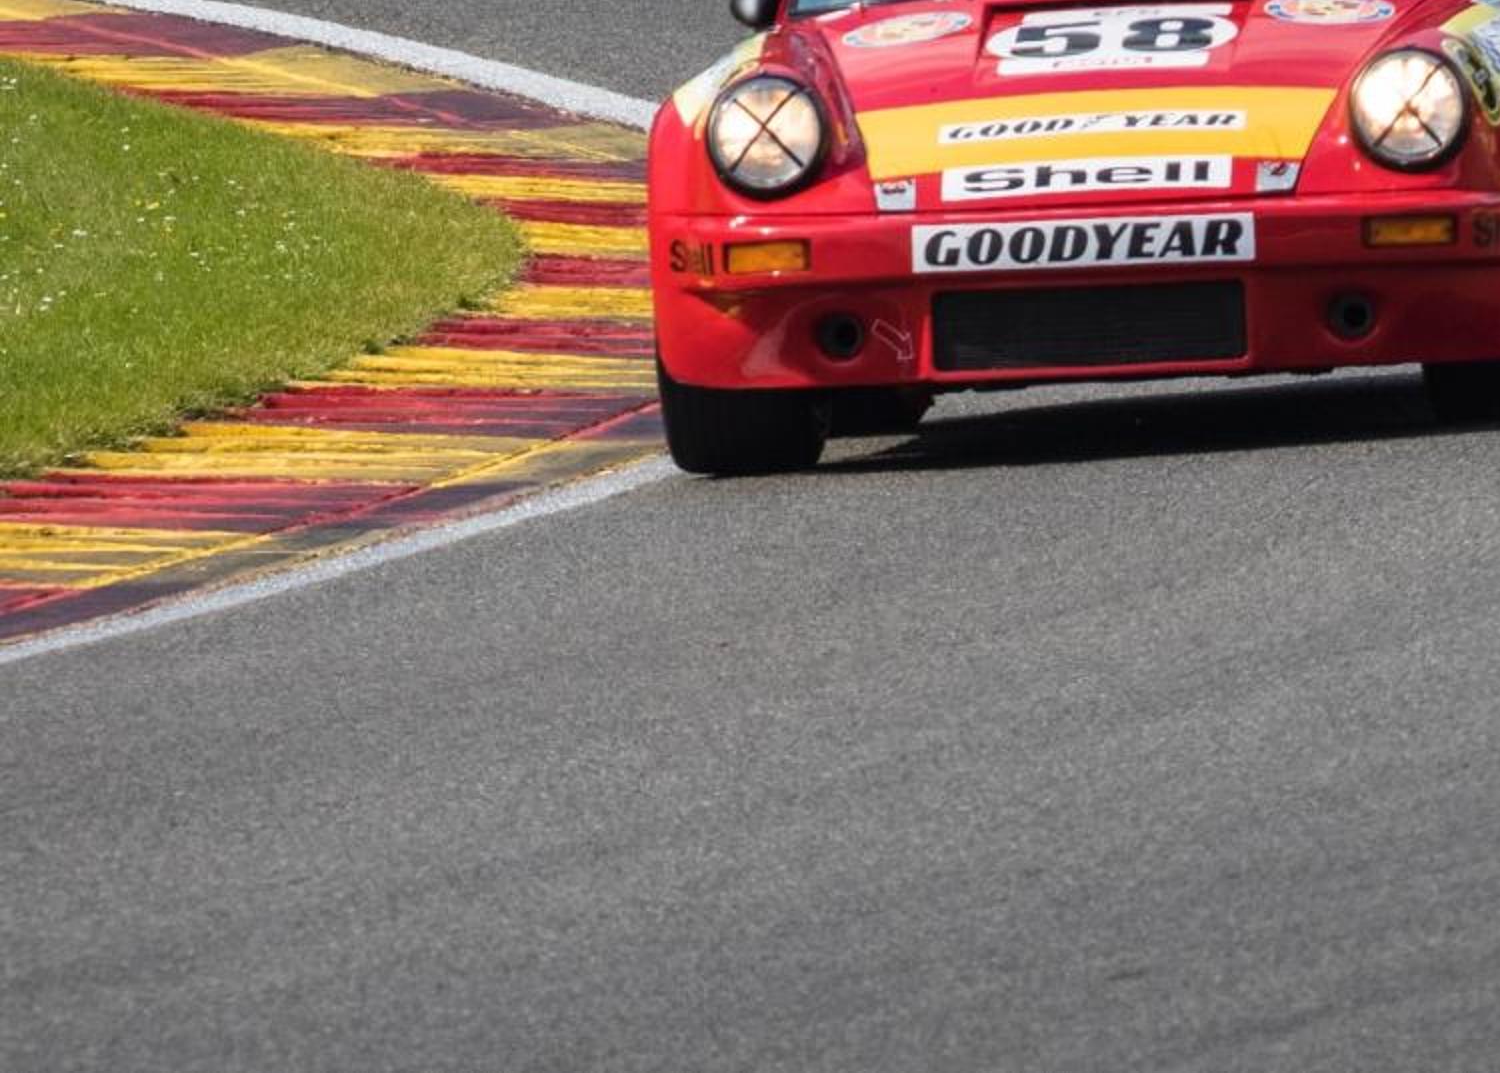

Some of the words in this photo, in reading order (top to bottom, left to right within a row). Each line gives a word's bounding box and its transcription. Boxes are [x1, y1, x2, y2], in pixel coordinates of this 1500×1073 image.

[1010, 17, 1216, 58] 58
[963, 161, 1210, 193] Shell
[924, 218, 1244, 267] GOODYEAR
